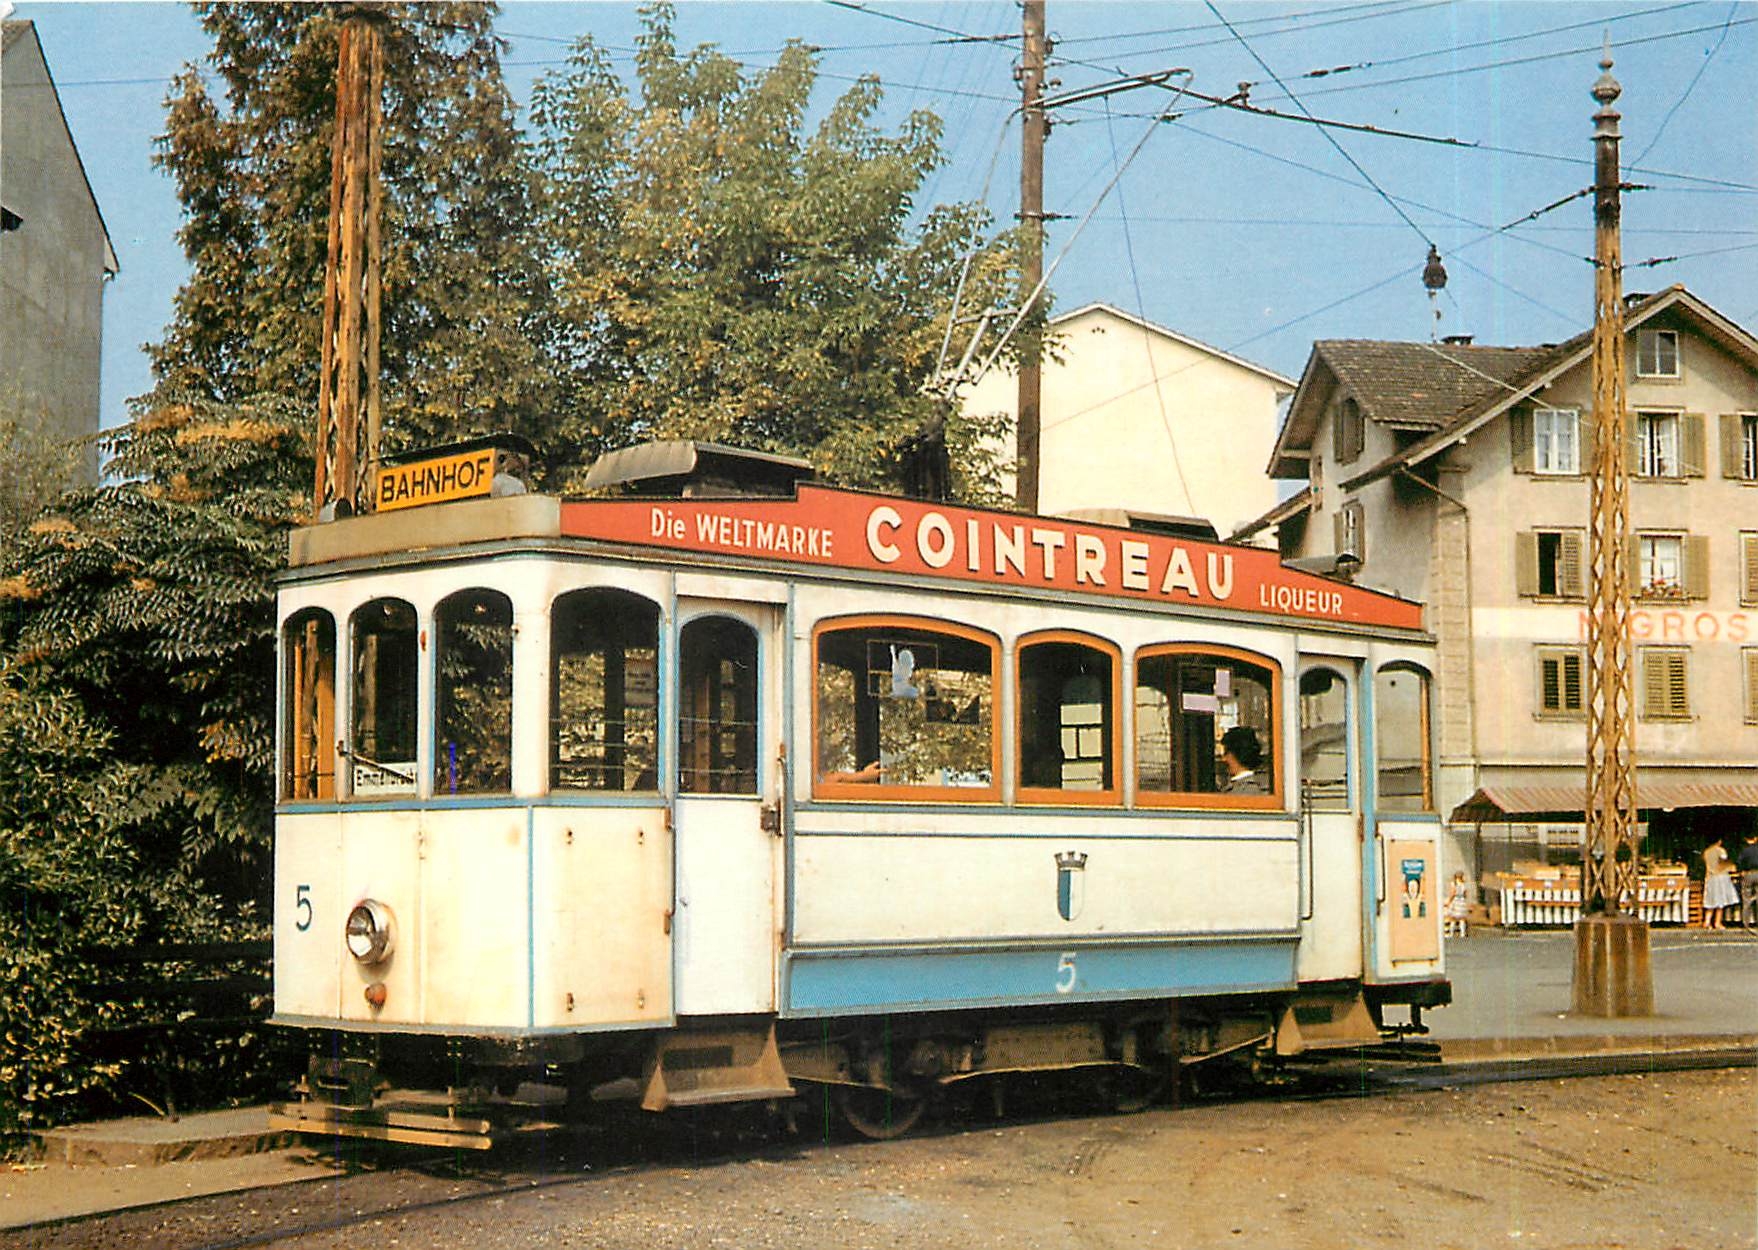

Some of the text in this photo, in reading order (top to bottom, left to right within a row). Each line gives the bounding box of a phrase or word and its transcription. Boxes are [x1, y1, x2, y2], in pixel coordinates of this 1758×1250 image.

[381, 457, 490, 503] BAHNHOF
[651, 505, 1343, 615] Die WELTMARKE COINTREAU LIQUEUR
[1578, 610, 1749, 642] MGROS
[295, 884, 313, 932] 5
[1055, 951, 1077, 994] 5
